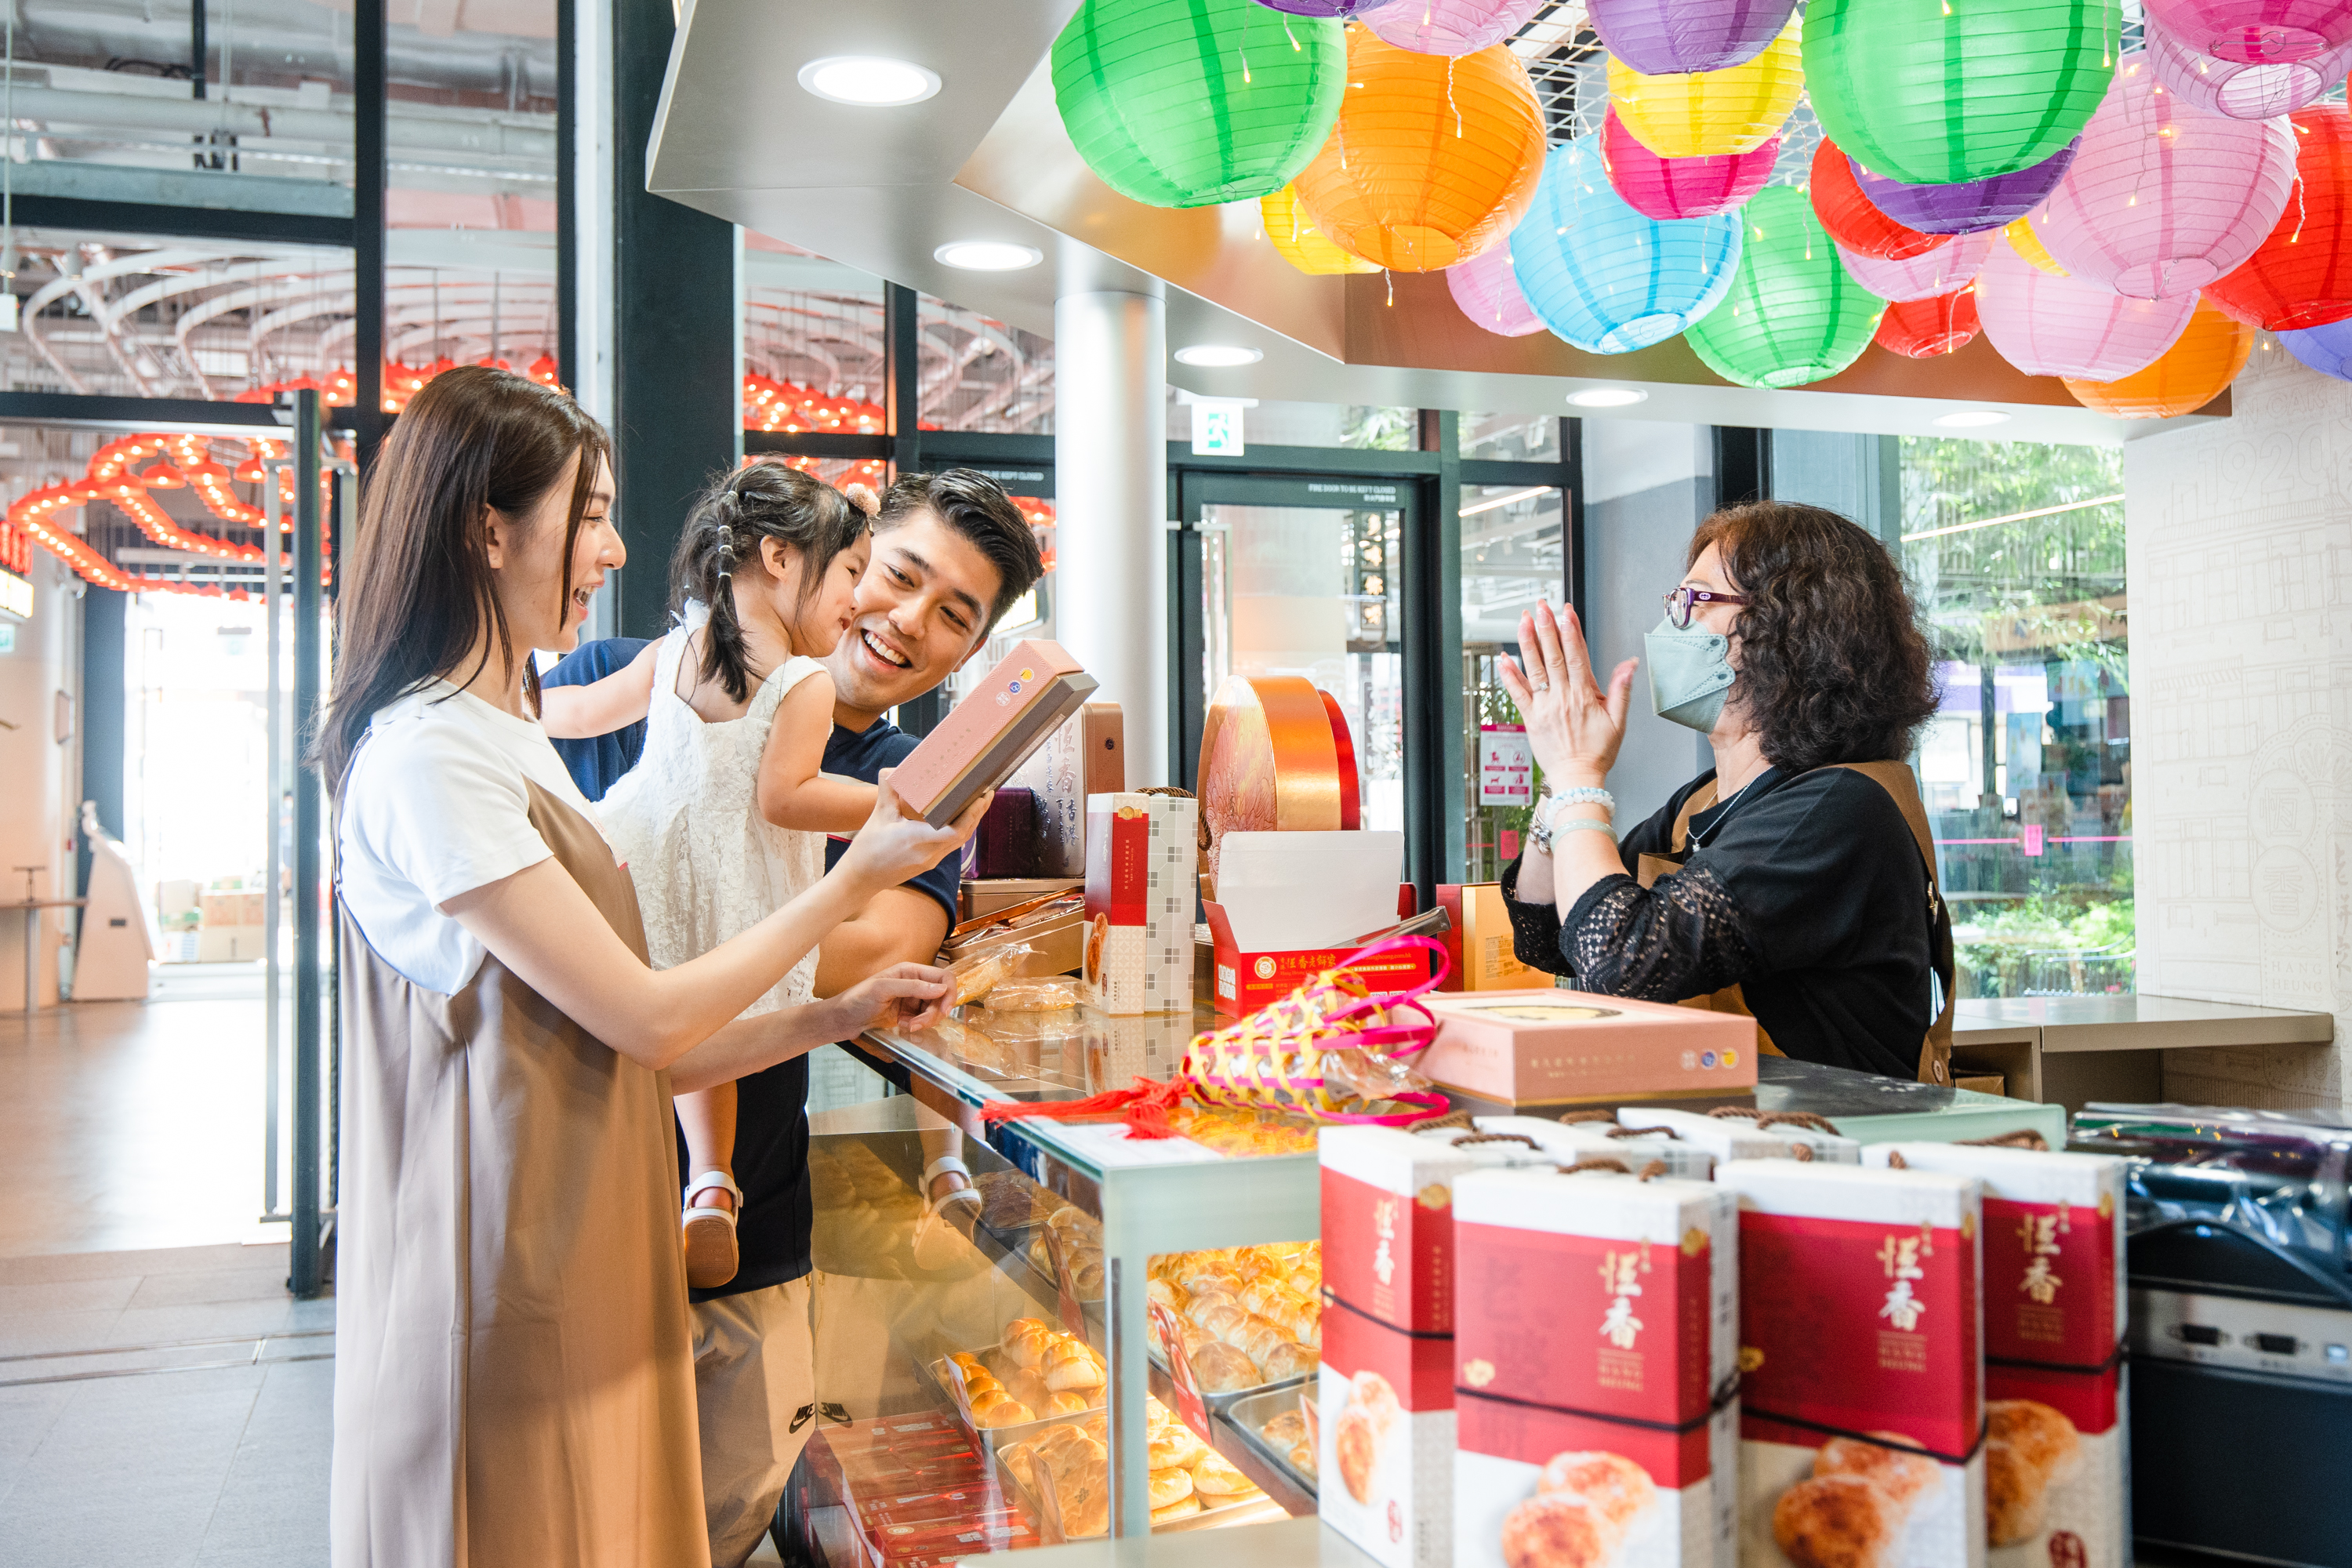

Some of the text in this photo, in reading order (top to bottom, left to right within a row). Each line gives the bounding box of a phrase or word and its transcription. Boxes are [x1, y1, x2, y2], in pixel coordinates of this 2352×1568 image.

[1308, 483, 1396, 495] FIRE DOOR TO BE KEPT CLOSED
[1065, 798, 1080, 847] 香港
[2272, 961, 2322, 975] HANG
[2272, 978, 2322, 993] HEUNG
[2016, 1212, 2064, 1305] 恒香
[1876, 1234, 1926, 1332] 恒香
[1598, 1249, 1644, 1351] 恒香
[794, 1403, 815, 1421] NIKE
